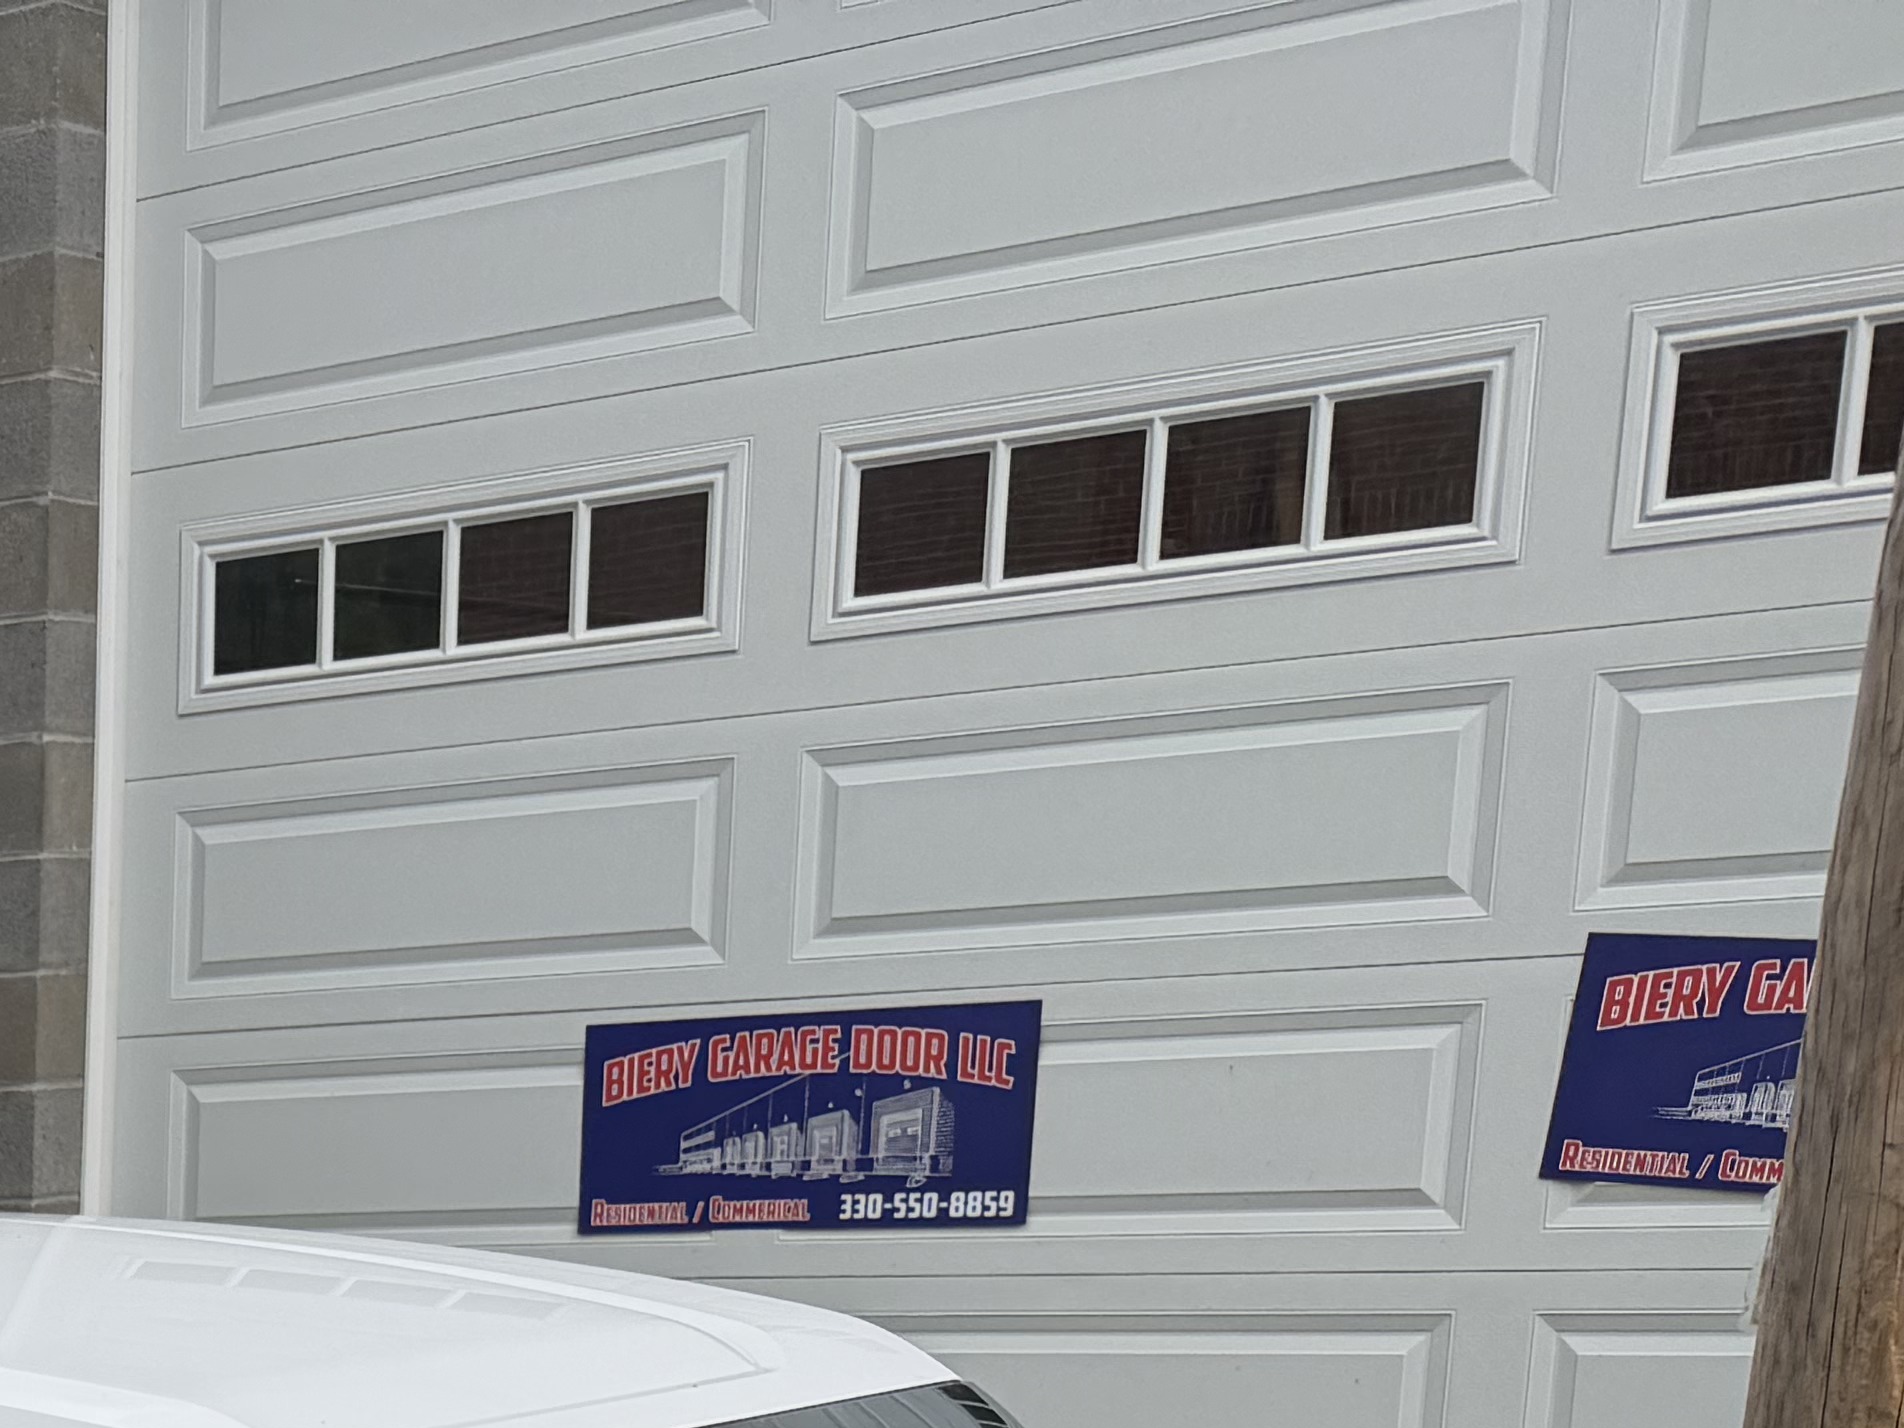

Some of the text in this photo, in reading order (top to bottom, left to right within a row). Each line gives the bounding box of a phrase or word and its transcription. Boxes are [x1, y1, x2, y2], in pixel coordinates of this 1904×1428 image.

[1597, 958, 1814, 1031] BIERY GA
[602, 1025, 1016, 1107] BIERY GARAGE DOOR LLC
[839, 1190, 1015, 1220] 330-550-8859
